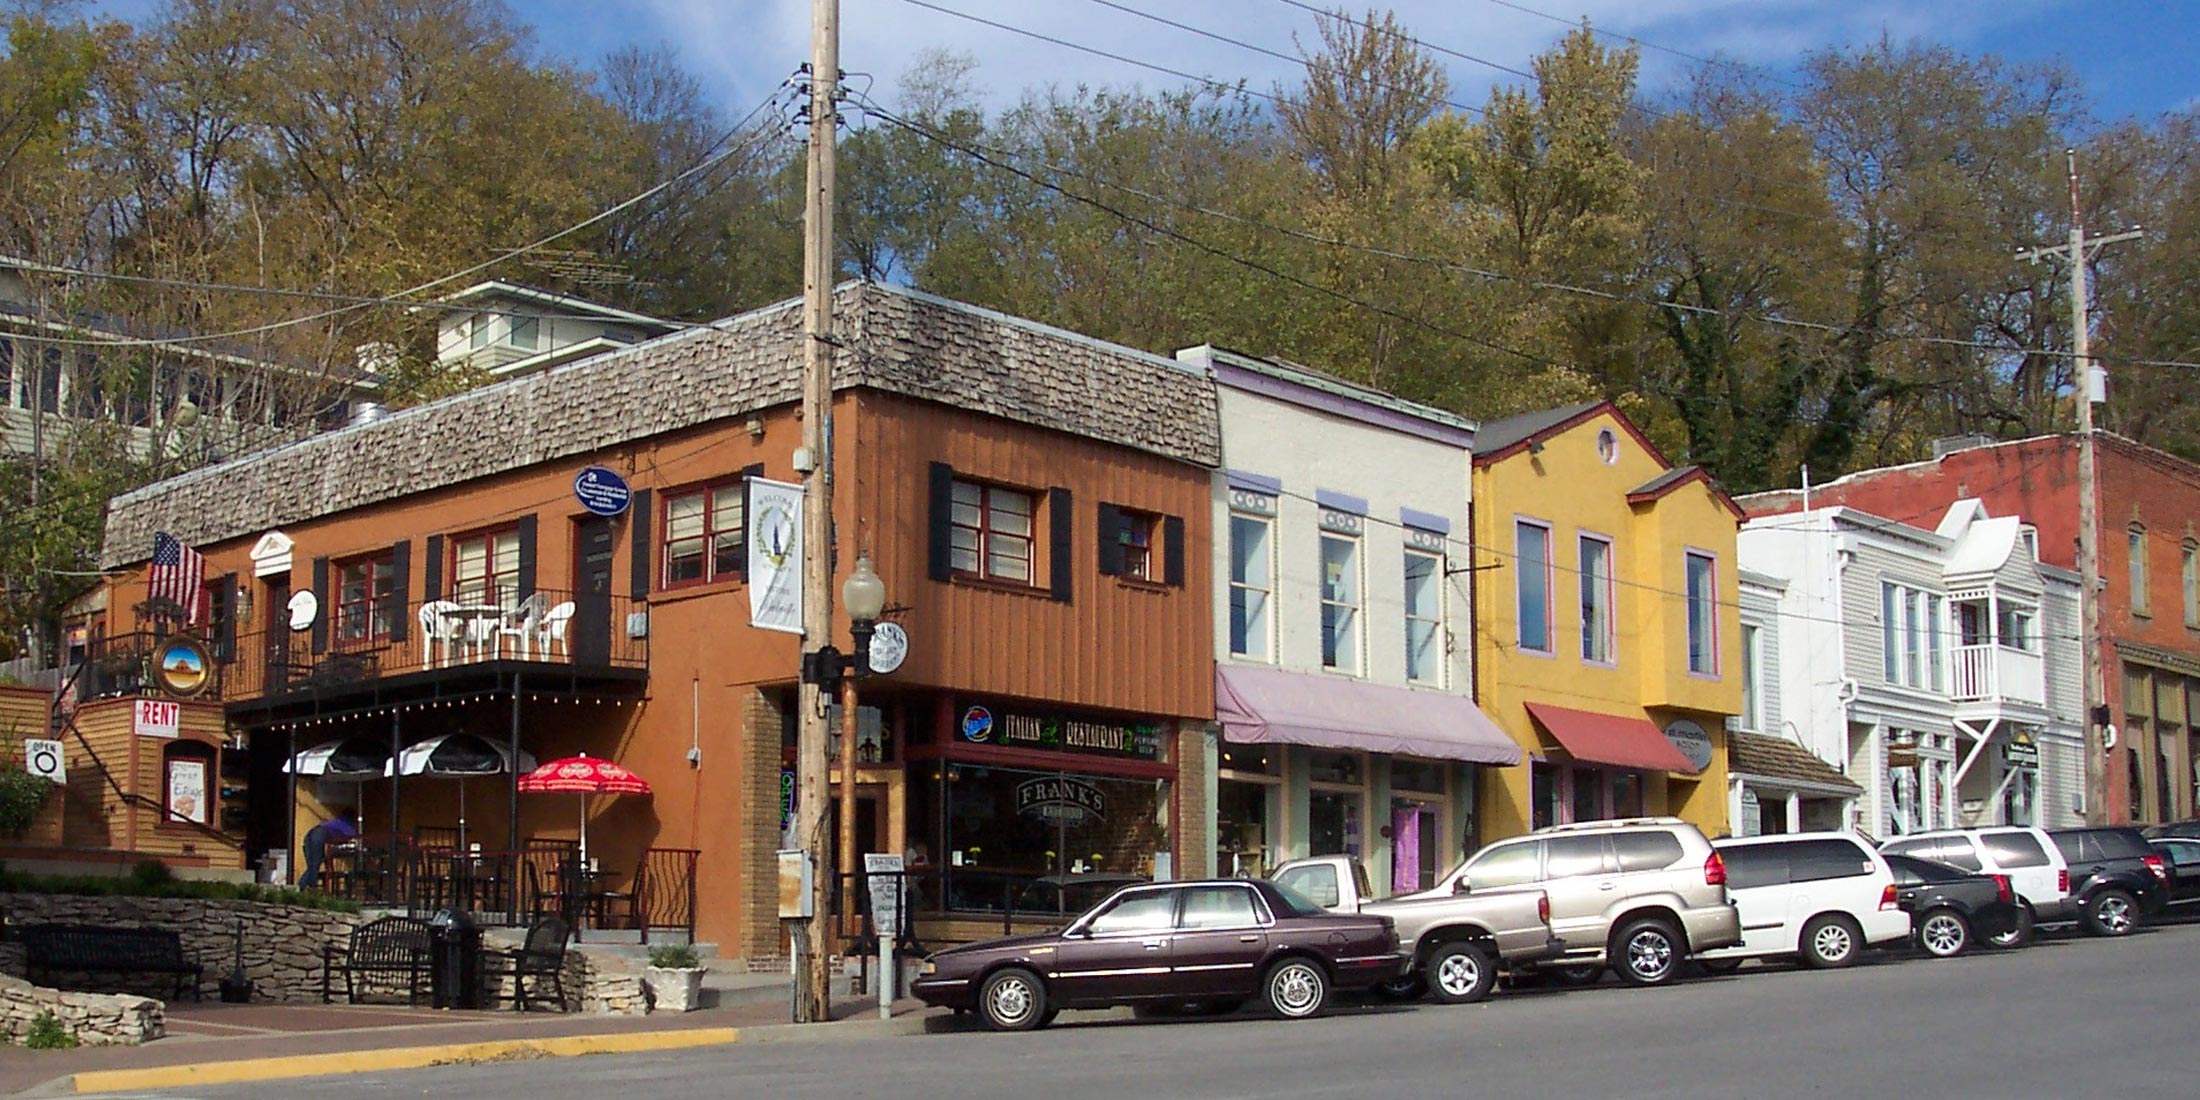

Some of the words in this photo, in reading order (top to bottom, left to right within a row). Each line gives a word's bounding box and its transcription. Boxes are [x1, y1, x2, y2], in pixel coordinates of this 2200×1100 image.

[142, 701, 178, 727] RENT
[1006, 714, 1041, 741] ITALIAN
[1066, 721, 1125, 750] RESTAURANT
[781, 774, 793, 823] OPEN
[1022, 782, 1103, 810] FRANK'S
